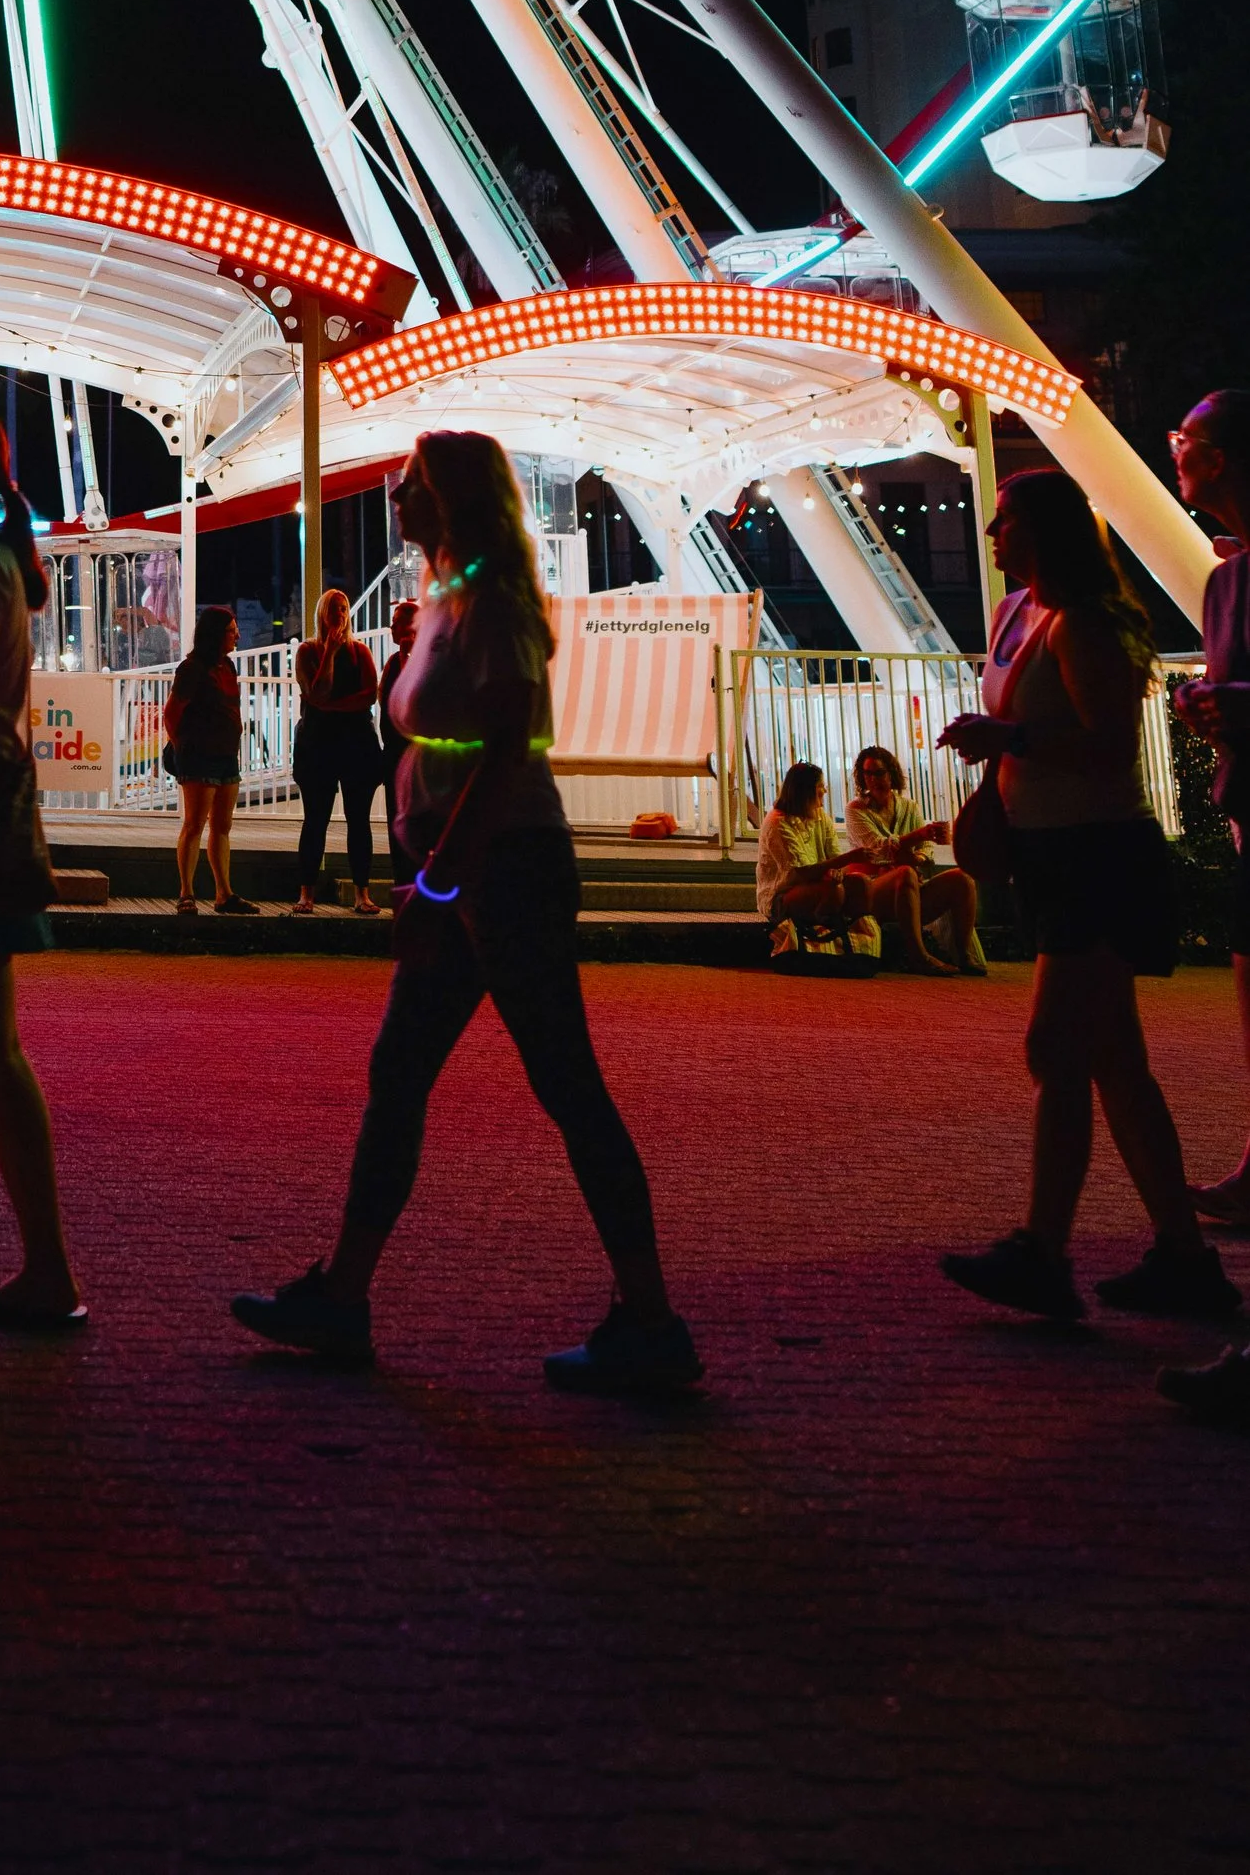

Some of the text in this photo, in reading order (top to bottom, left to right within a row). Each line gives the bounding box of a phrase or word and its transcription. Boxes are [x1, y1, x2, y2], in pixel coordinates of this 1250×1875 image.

[586, 620, 710, 634] #jettyrdglenelg
[47, 699, 73, 727] in
[33, 730, 102, 761] aide
